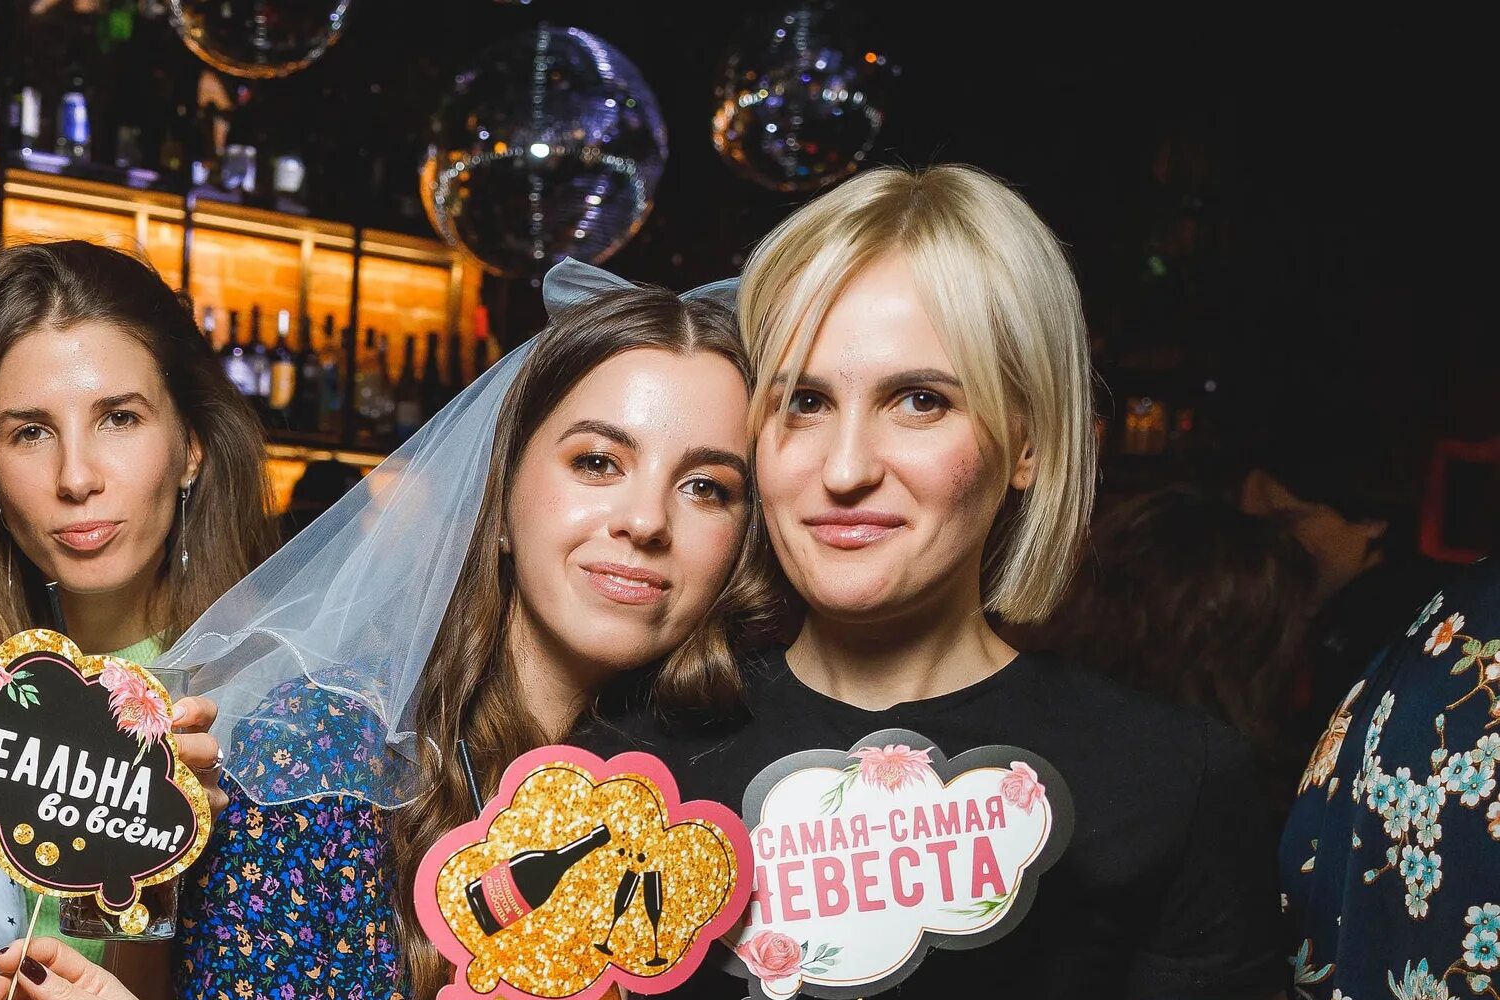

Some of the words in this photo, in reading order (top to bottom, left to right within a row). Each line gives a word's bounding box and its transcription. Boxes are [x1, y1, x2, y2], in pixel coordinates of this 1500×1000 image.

[37, 793, 80, 827] во
[85, 805, 185, 853] всём!
[756, 795, 1006, 861] САМАЯ-САМАЯ
